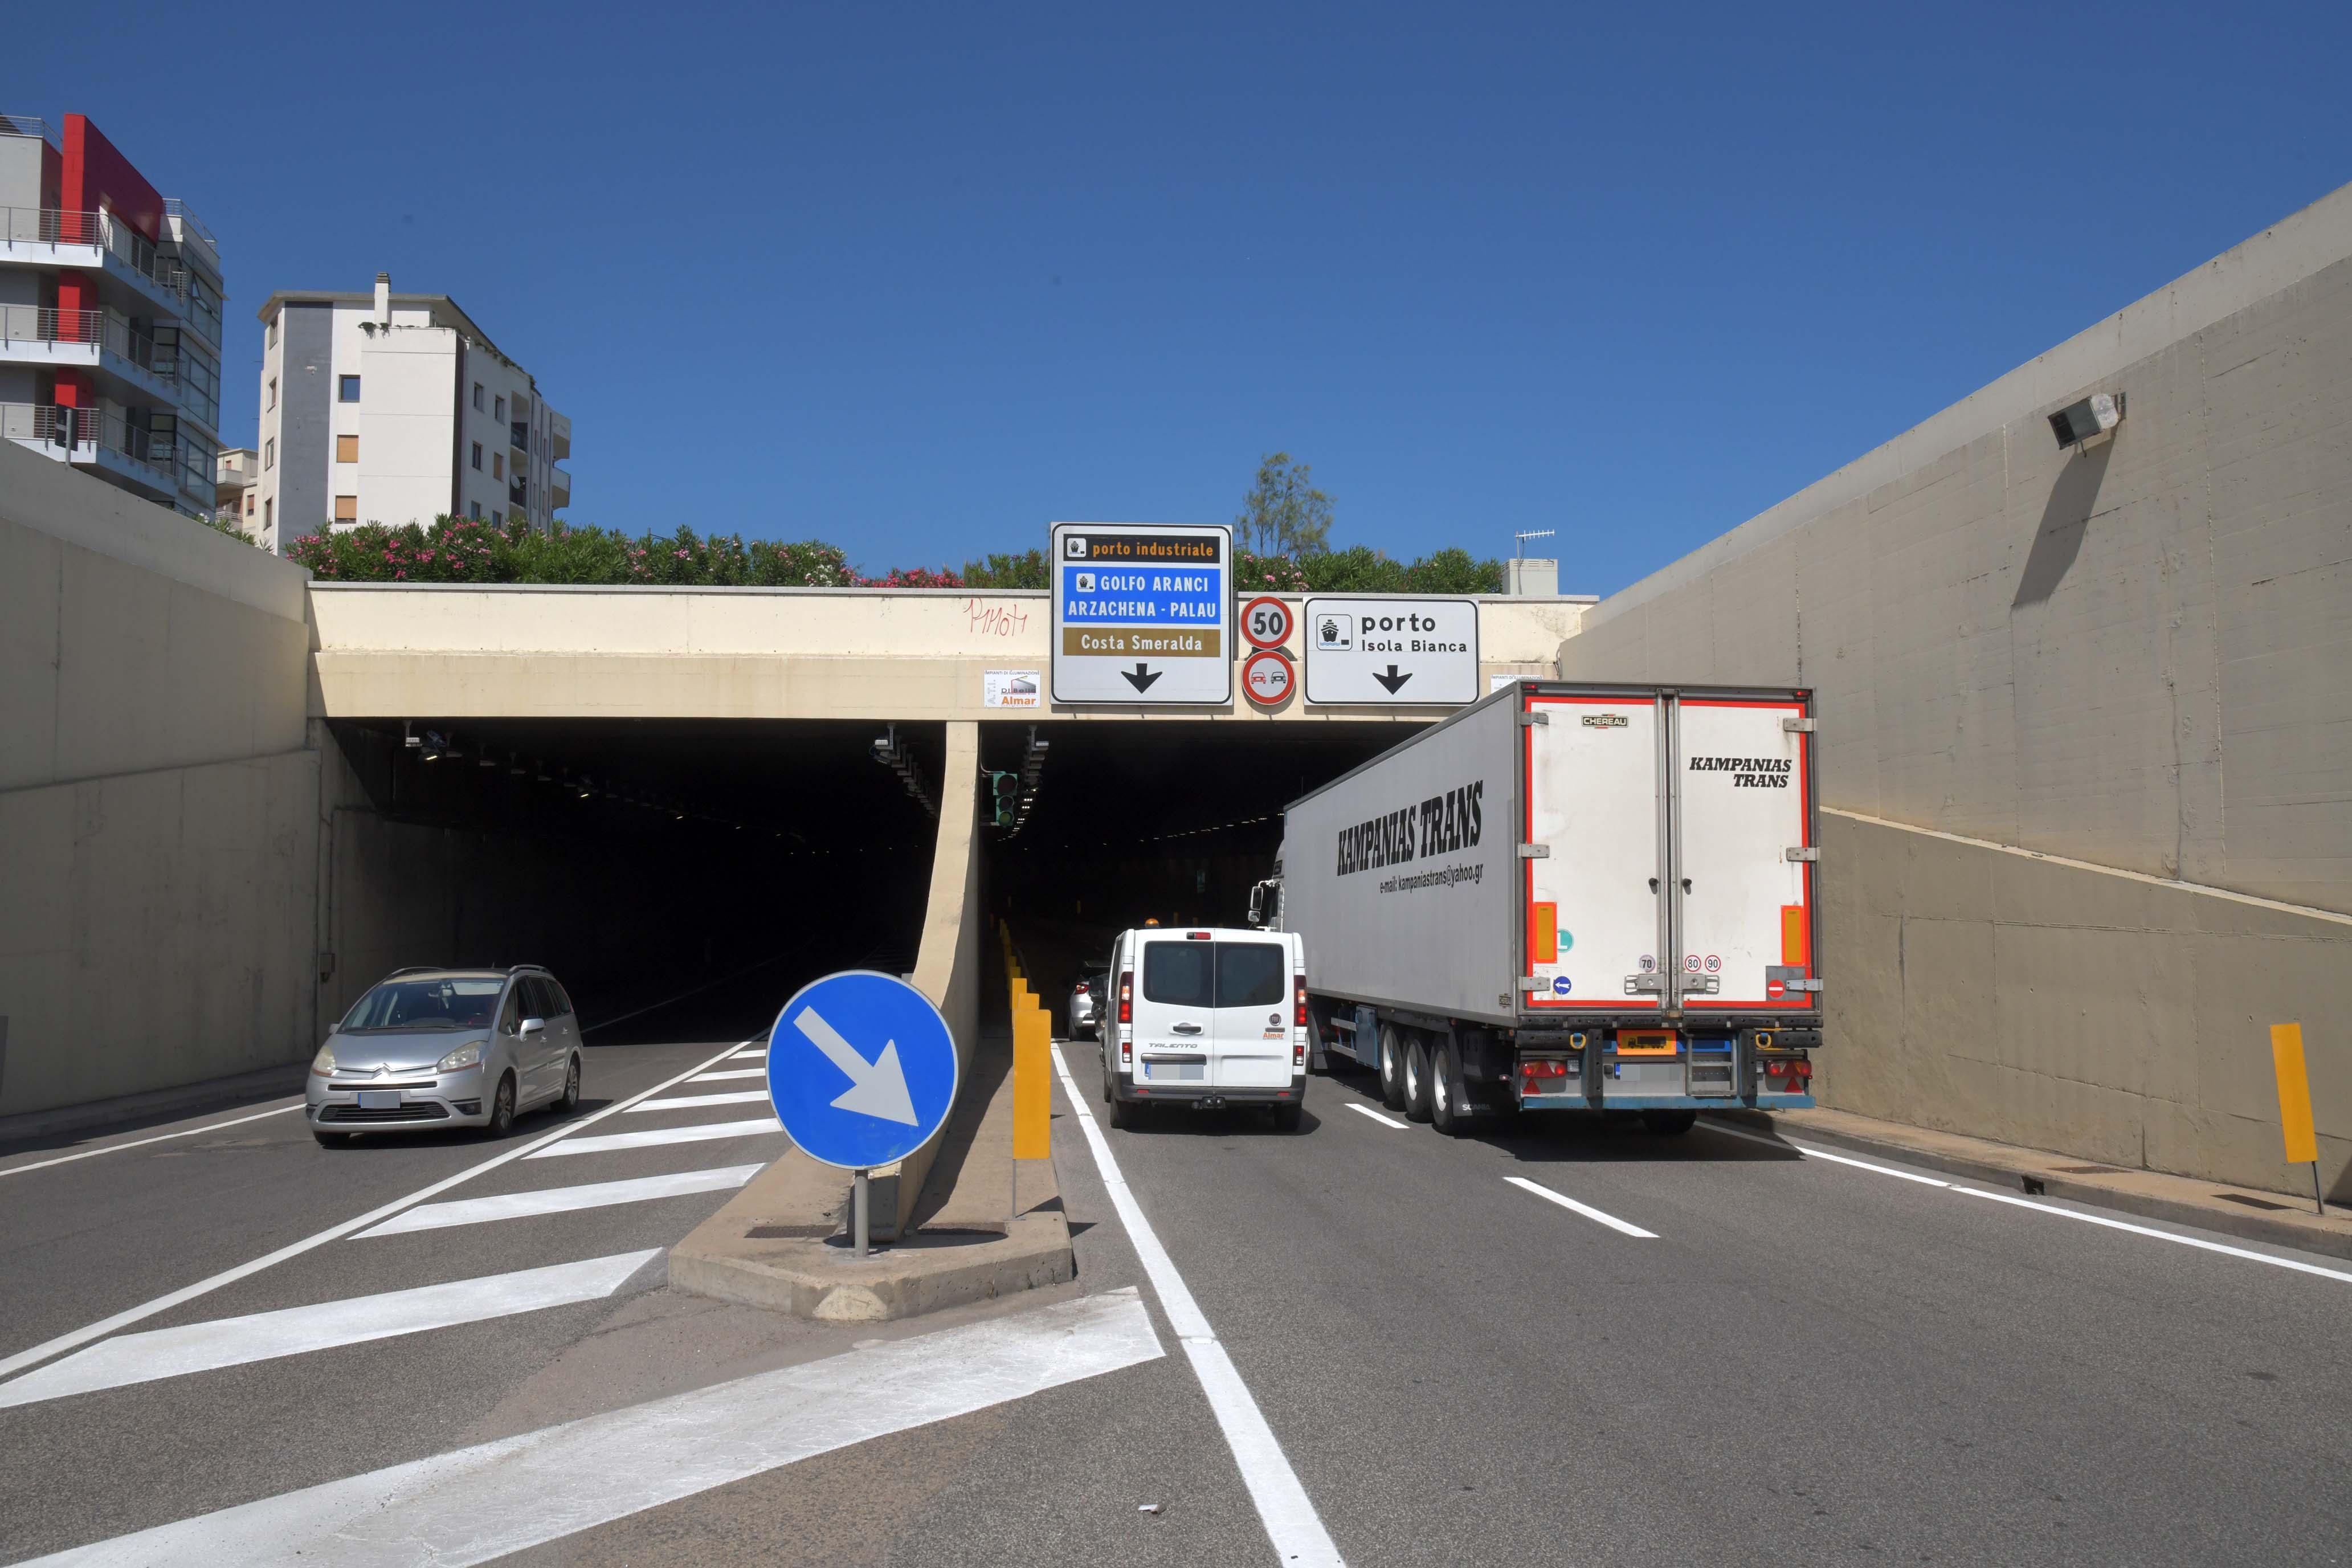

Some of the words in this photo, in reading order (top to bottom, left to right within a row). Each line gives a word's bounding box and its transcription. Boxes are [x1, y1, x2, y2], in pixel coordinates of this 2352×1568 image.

[1093, 542, 1130, 557] porto
[1137, 542, 1213, 556] industriale
[1101, 575, 1145, 591] GOLFO
[1153, 577, 1208, 592] ARANCI
[1068, 601, 1156, 616] ARZACHENA
[1170, 602, 1216, 618] PALAU
[1253, 612, 1283, 635] 50
[1362, 613, 1435, 634] porto
[1081, 634, 1124, 650] Costa
[1132, 635, 1202, 651] Smeralda
[1362, 639, 1403, 652] Isola
[1411, 640, 1467, 652] Bianca
[1002, 696, 1036, 705] Almar
[1689, 757, 1792, 773] KAMPANIAS
[1733, 774, 1788, 788] TRANS
[1337, 805, 1416, 876] KAMPANIAS
[1420, 780, 1483, 858] TRANS
[1380, 875, 1397, 893] e-mail:
[1398, 863, 1484, 893] kampaniastrans@yahoo.gr
[1642, 959, 1652, 969] 70
[1688, 959, 1698, 968] 80
[1708, 959, 1718, 968] 90
